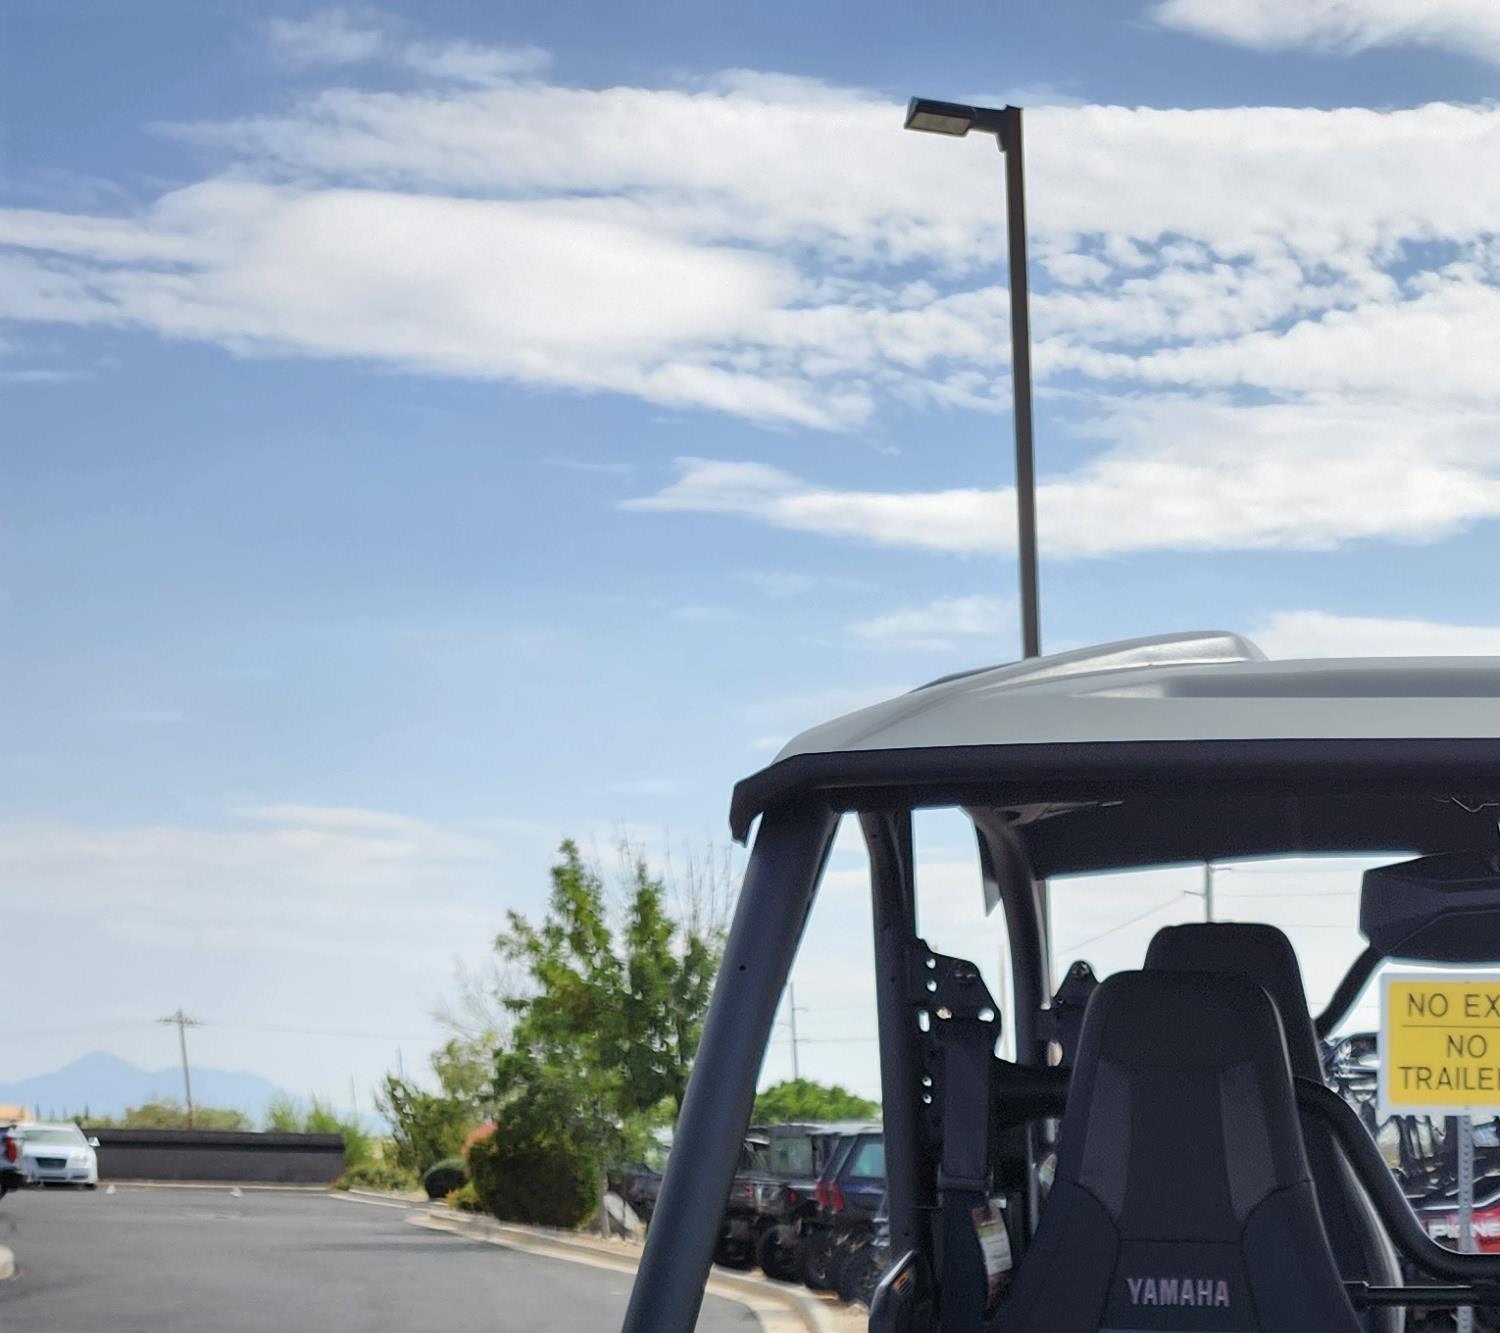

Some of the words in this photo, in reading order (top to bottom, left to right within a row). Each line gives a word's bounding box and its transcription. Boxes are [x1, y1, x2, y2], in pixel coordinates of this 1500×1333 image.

[1407, 992, 1449, 1018] NO
[1447, 1034, 1488, 1059] NO
[1127, 1278, 1230, 1307] YAMAHA
